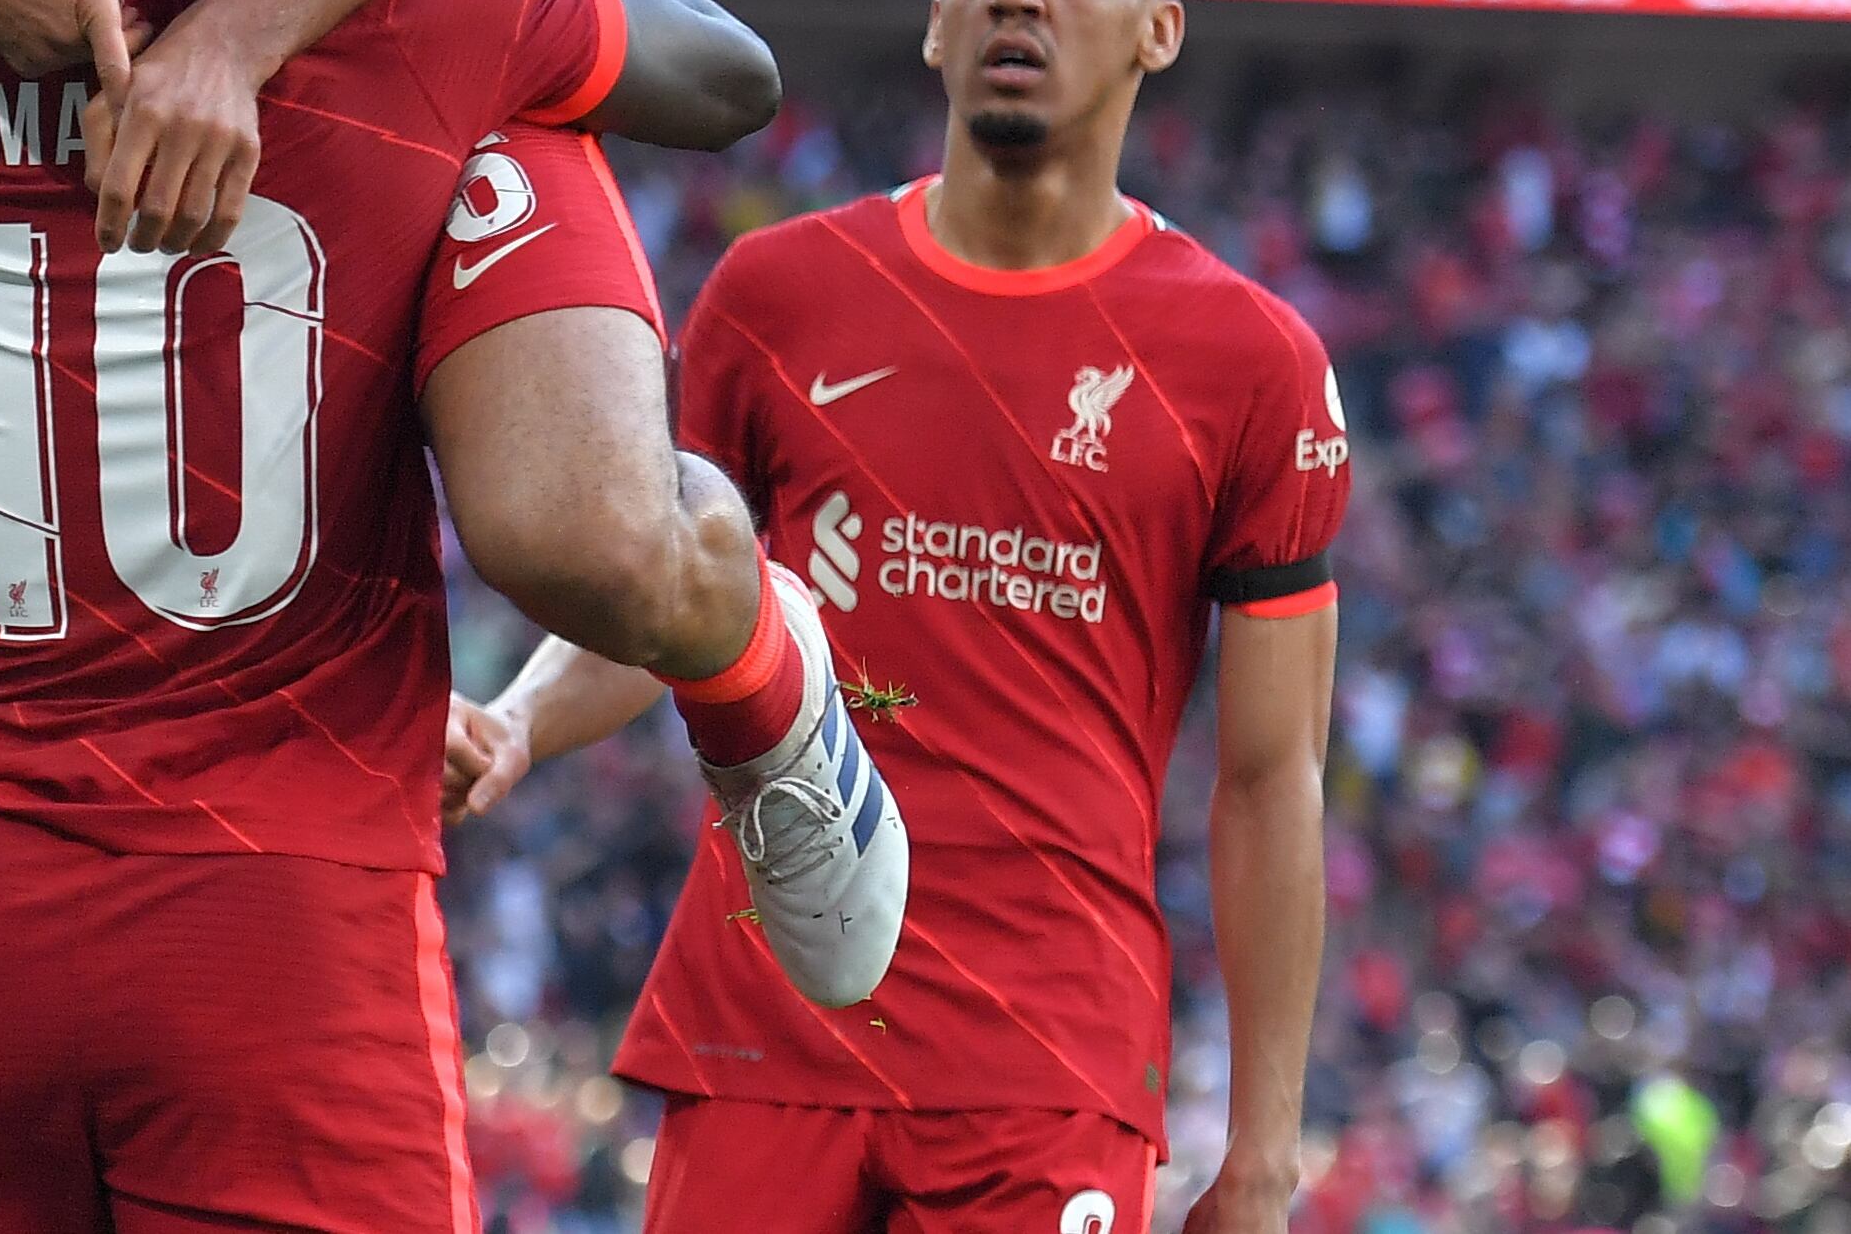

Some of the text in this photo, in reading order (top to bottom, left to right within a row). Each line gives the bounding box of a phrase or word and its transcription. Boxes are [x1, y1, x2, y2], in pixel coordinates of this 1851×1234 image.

[1294, 428, 1349, 479] Exp
[881, 510, 1102, 582] standard
[878, 555, 1107, 624] chartered
